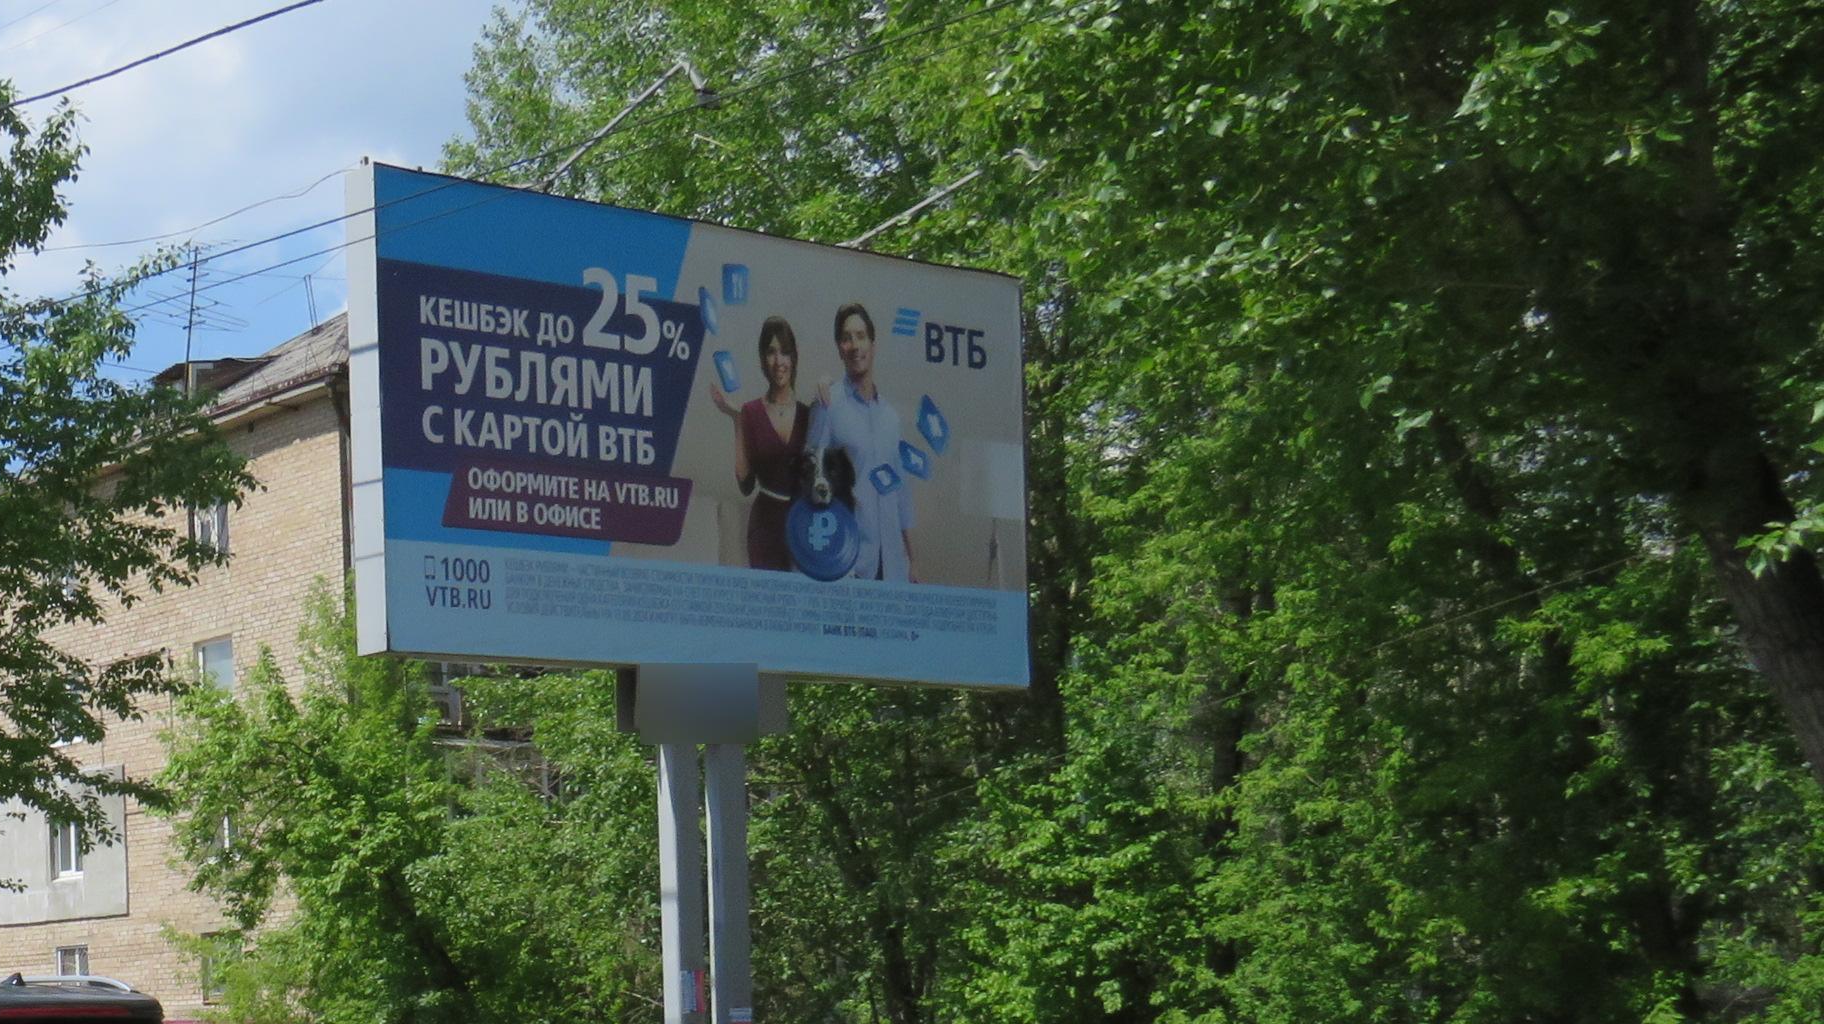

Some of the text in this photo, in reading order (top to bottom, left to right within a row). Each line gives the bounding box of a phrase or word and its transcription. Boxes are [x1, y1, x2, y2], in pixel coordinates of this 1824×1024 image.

[419, 295, 530, 338] КЕШБЭК
[536, 312, 575, 348] ДО
[925, 322, 987, 369] ВТБ
[420, 337, 654, 417] РУБЛЯМИ
[422, 405, 655, 465] С КАРТОЙ ВТБ
[467, 466, 679, 509] ОФОРМИТЕ НА VTB.RU
[468, 496, 602, 530] ИЛИ В ОФИСЕ
[440, 557, 491, 583] 1000
[426, 585, 491, 610] VTB.RU
